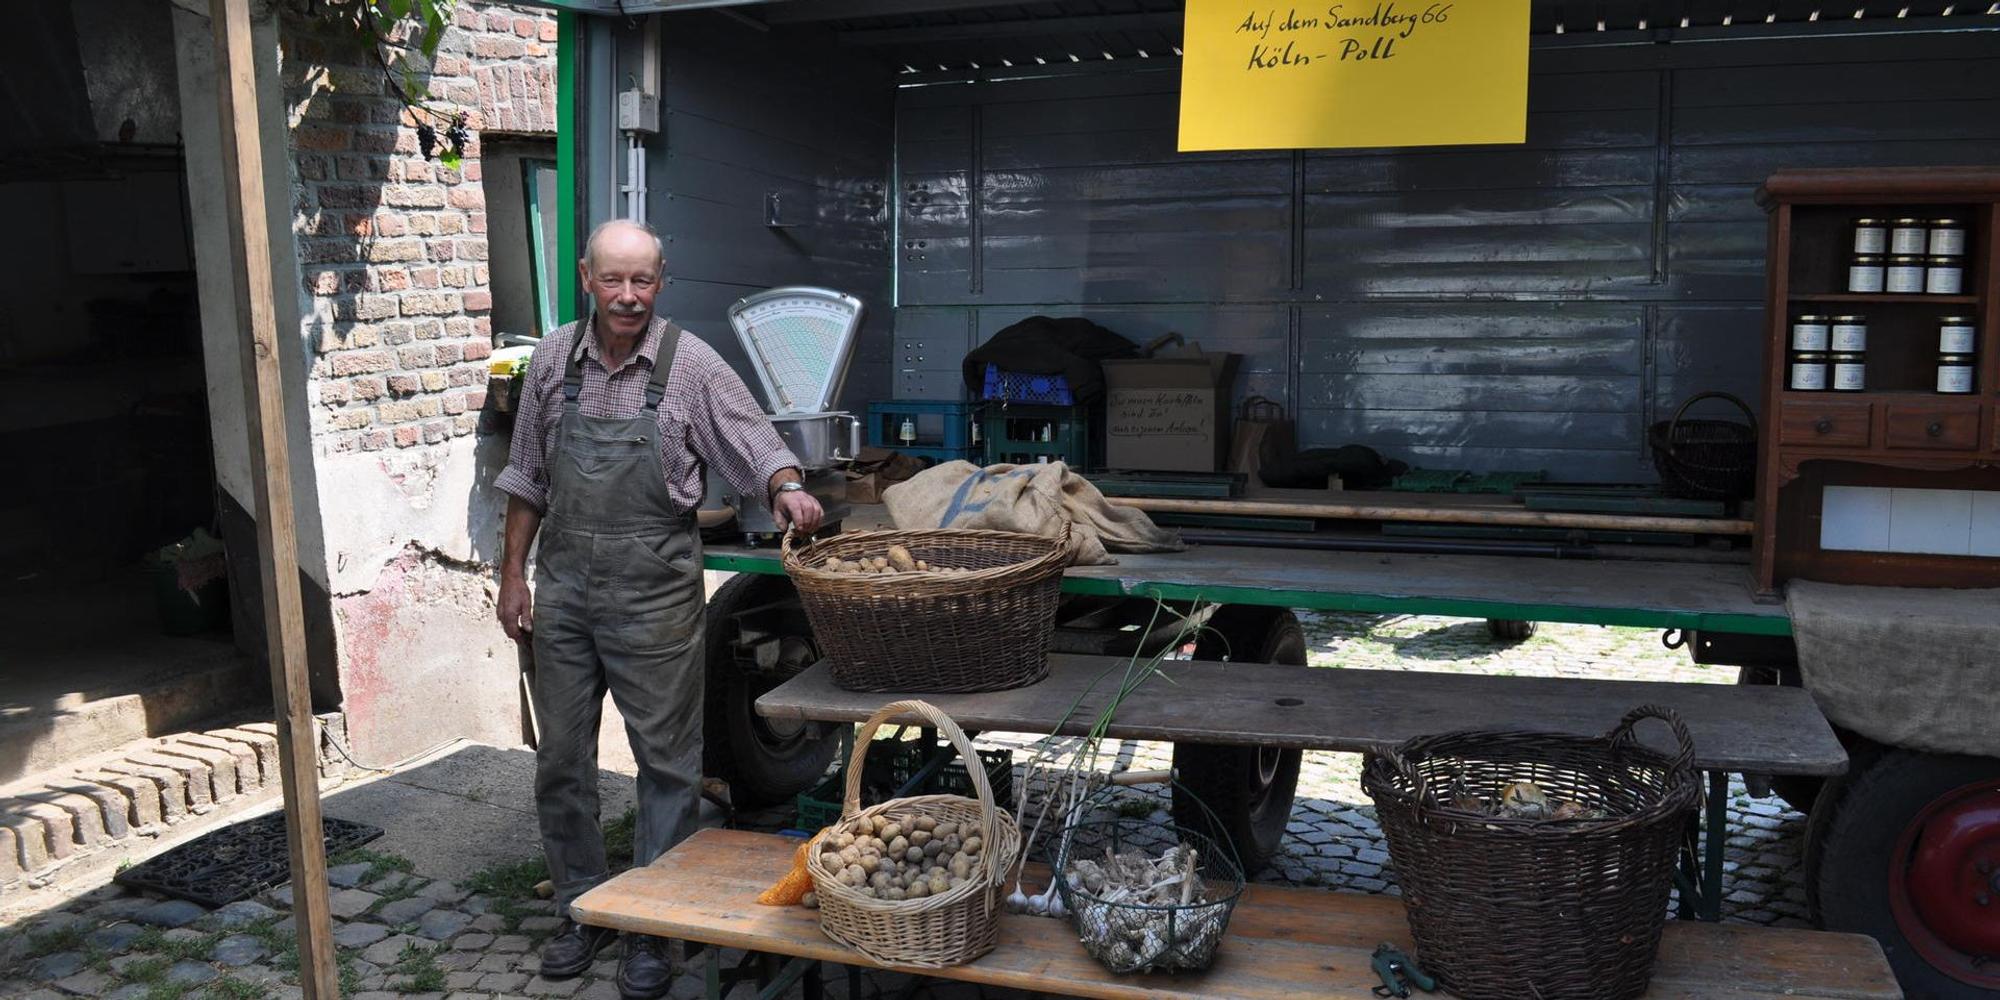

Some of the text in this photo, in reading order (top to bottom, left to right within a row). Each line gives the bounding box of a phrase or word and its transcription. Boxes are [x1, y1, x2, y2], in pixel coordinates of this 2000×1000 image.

[1236, 2, 1453, 39] Auf dem Sandberg 66
[1340, 37, 1395, 61] Poll
